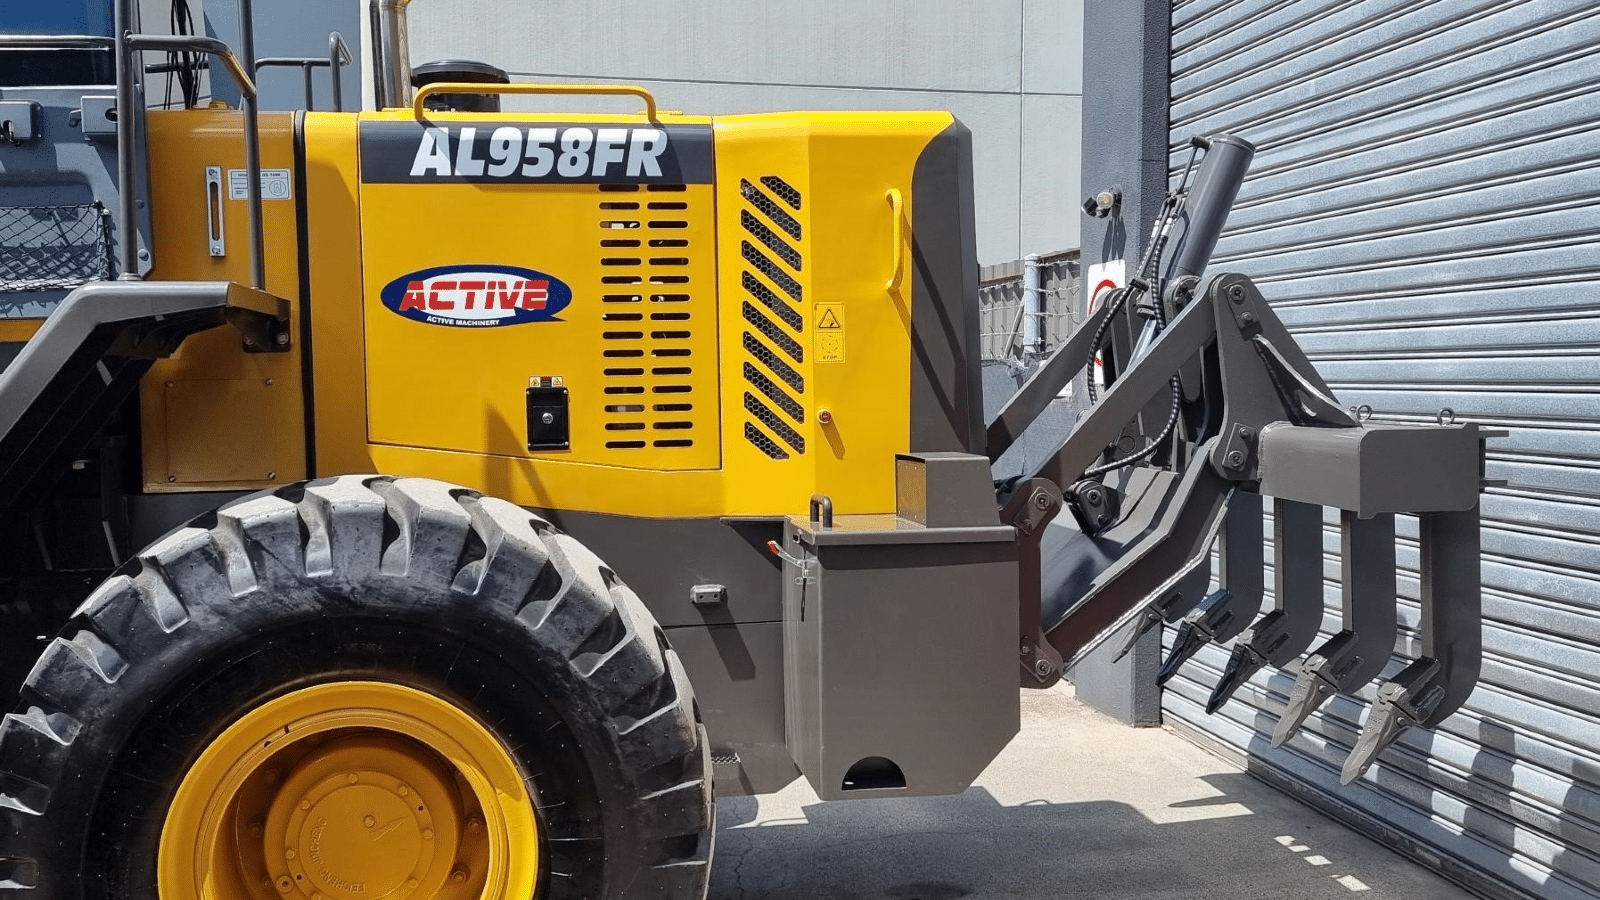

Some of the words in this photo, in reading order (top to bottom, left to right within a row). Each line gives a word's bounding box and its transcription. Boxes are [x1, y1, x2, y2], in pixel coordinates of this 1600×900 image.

[409, 126, 668, 178] AL958FR
[399, 280, 550, 311] ACTIVE
[426, 315, 455, 326] ACTIVE
[455, 317, 500, 327] MACHINERY
